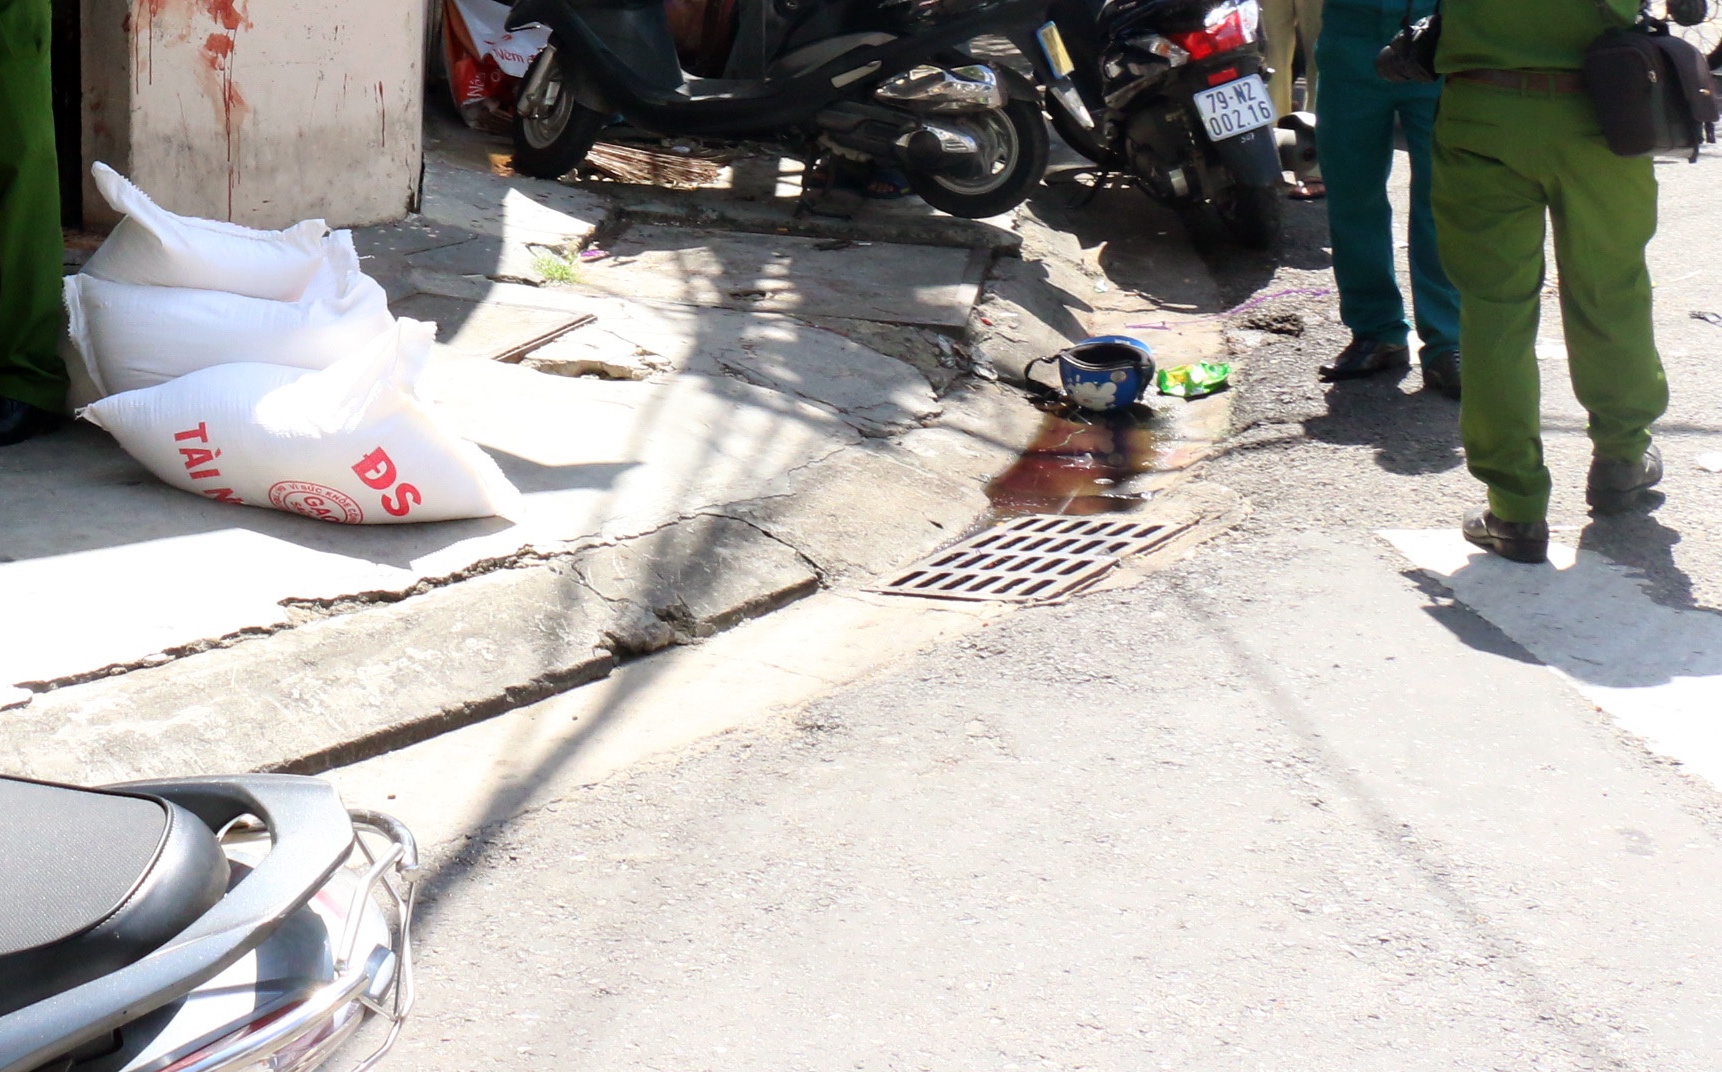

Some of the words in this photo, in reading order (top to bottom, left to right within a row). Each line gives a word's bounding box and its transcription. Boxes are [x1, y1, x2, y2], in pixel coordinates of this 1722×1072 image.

[1205, 81, 1257, 114] 79-N2
[1209, 100, 1271, 136] 002.16
[174, 421, 224, 481] TÀI
[351, 446, 422, 518] ĐS
